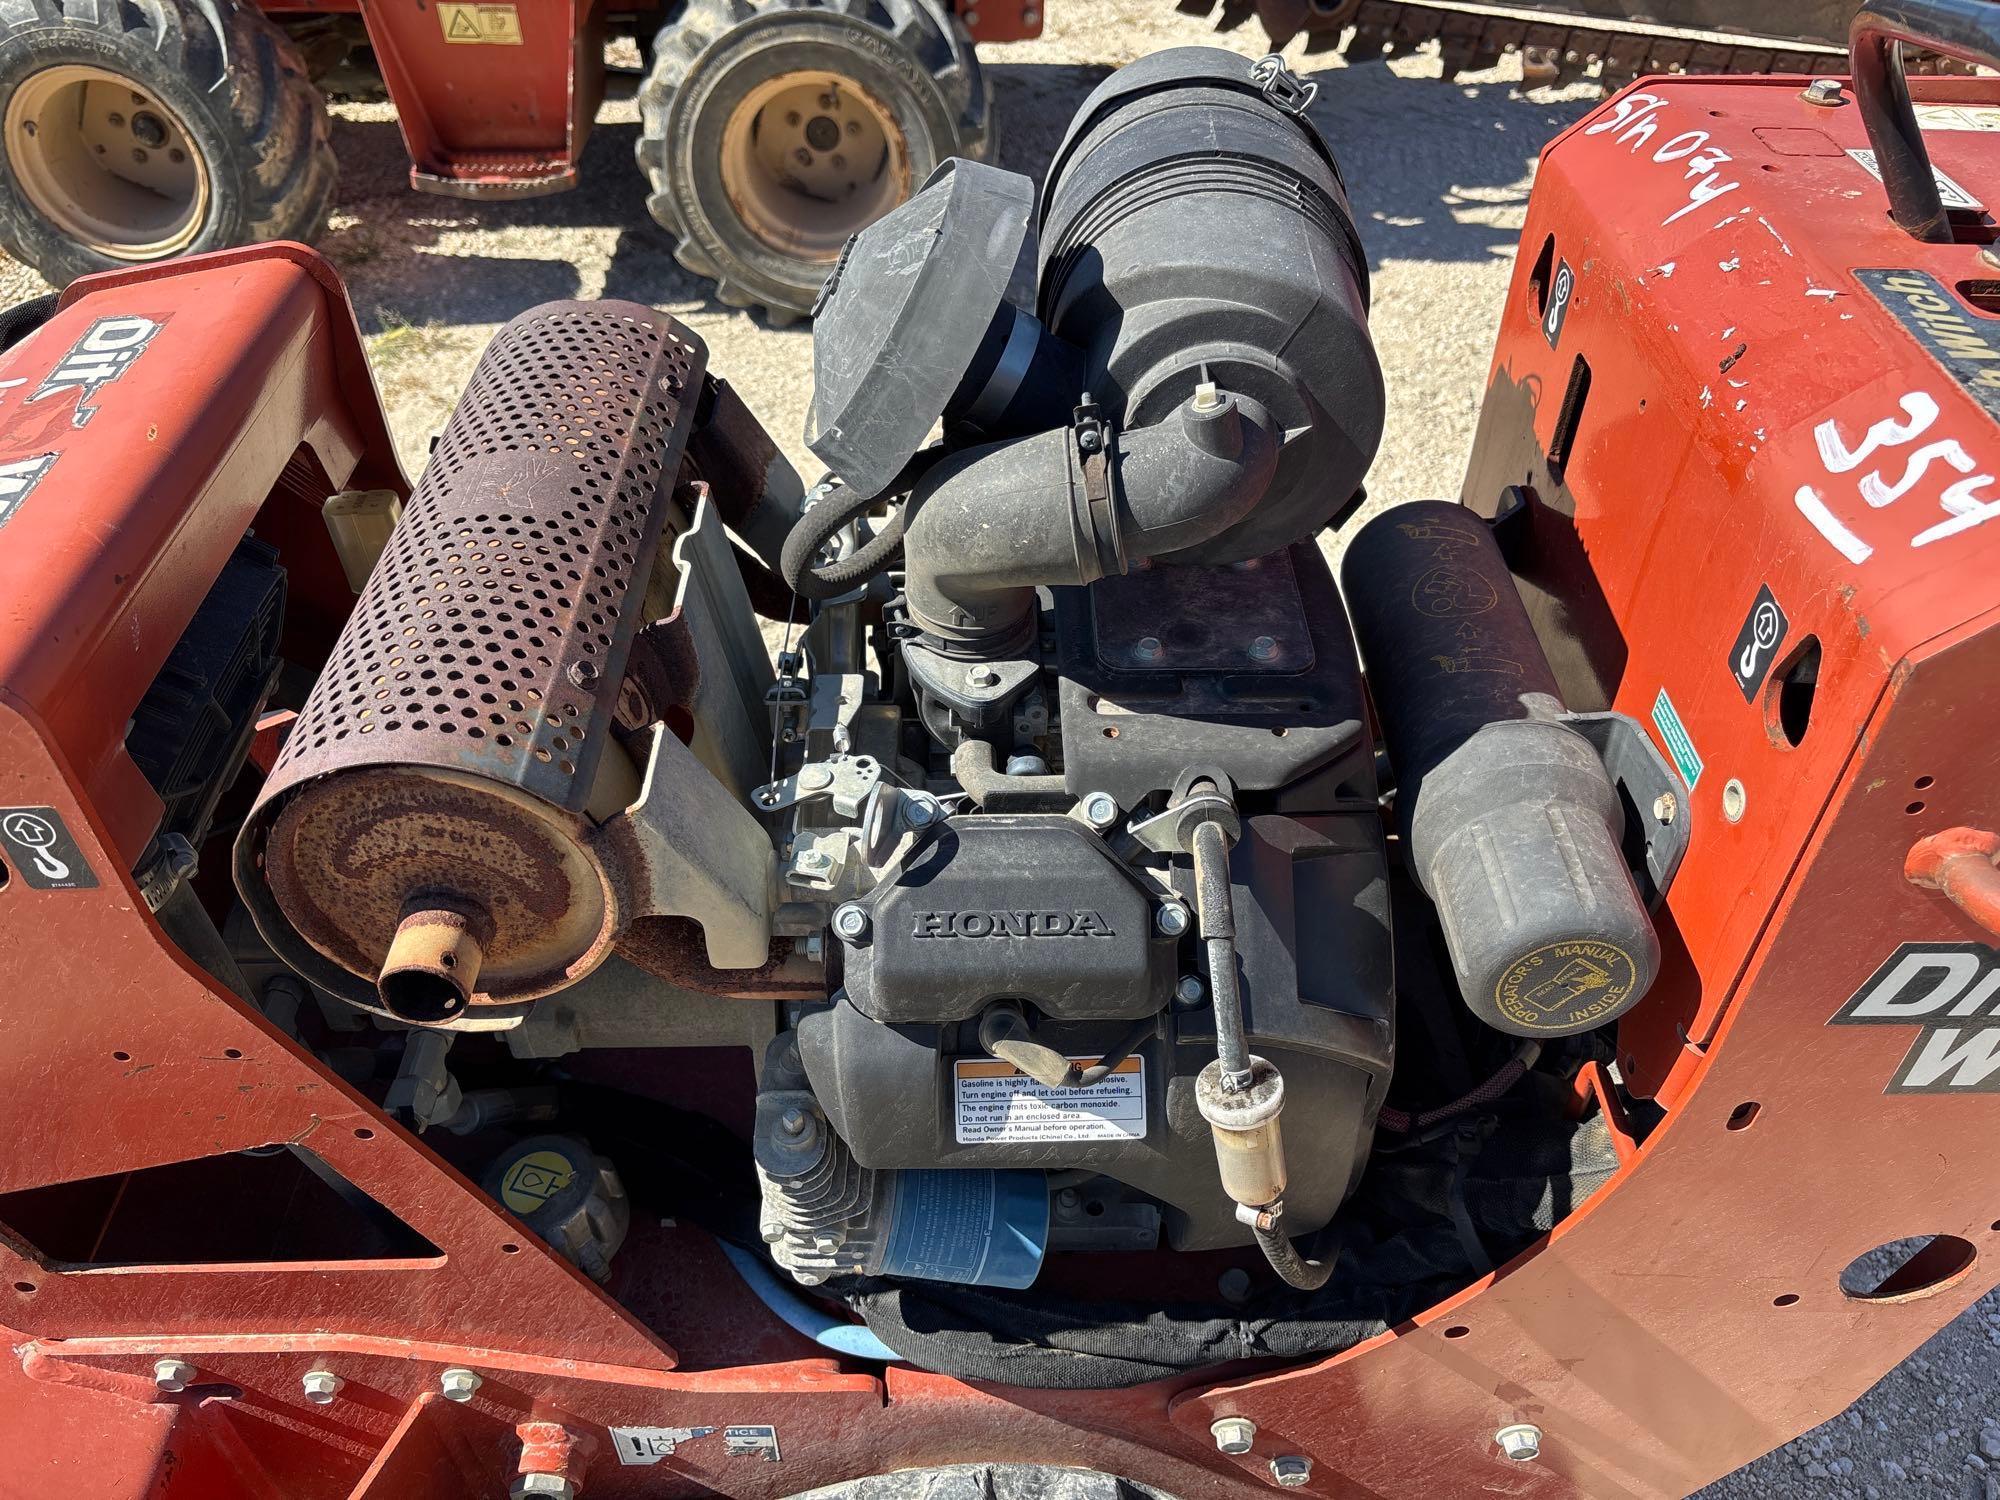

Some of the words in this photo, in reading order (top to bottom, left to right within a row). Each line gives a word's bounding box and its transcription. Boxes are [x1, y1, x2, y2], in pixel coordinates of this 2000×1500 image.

[1881, 276, 2000, 360] Witch
[912, 910, 1116, 938] HONDA
[1504, 956, 1544, 1022] OPERATOR'S
[1554, 944, 1621, 967] MANUAL
[1569, 985, 1625, 1022] INSIDE
[961, 1079, 994, 1088] Gasoline
[996, 1079, 1003, 1087] is
[1004, 1078, 1028, 1088] highly
[1030, 1077, 1042, 1086] fla
[961, 1091, 979, 1099] Turn
[980, 1090, 1007, 1099] engine
[1009, 1089, 1020, 1098] off
[1022, 1089, 1036, 1097] and
[1038, 1088, 1049, 1097] let
[1050, 1088, 1067, 1096] cool
[1068, 1086, 1094, 1096] before
[1096, 1085, 1133, 1096] refueling.
[962, 1104, 977, 1112] The
[978, 1103, 1005, 1112] engine
[1006, 1103, 1028, 1111] emits
[1050, 1101, 1079, 1109] carbon
[1080, 1100, 1120, 1108] monoxide.
[1026, 1112, 1061, 1120] enclosed
[983, 1125, 1013, 1133] Owner's
[1014, 1124, 1042, 1132] Manual
[1069, 1123, 1106, 1132] operation.
